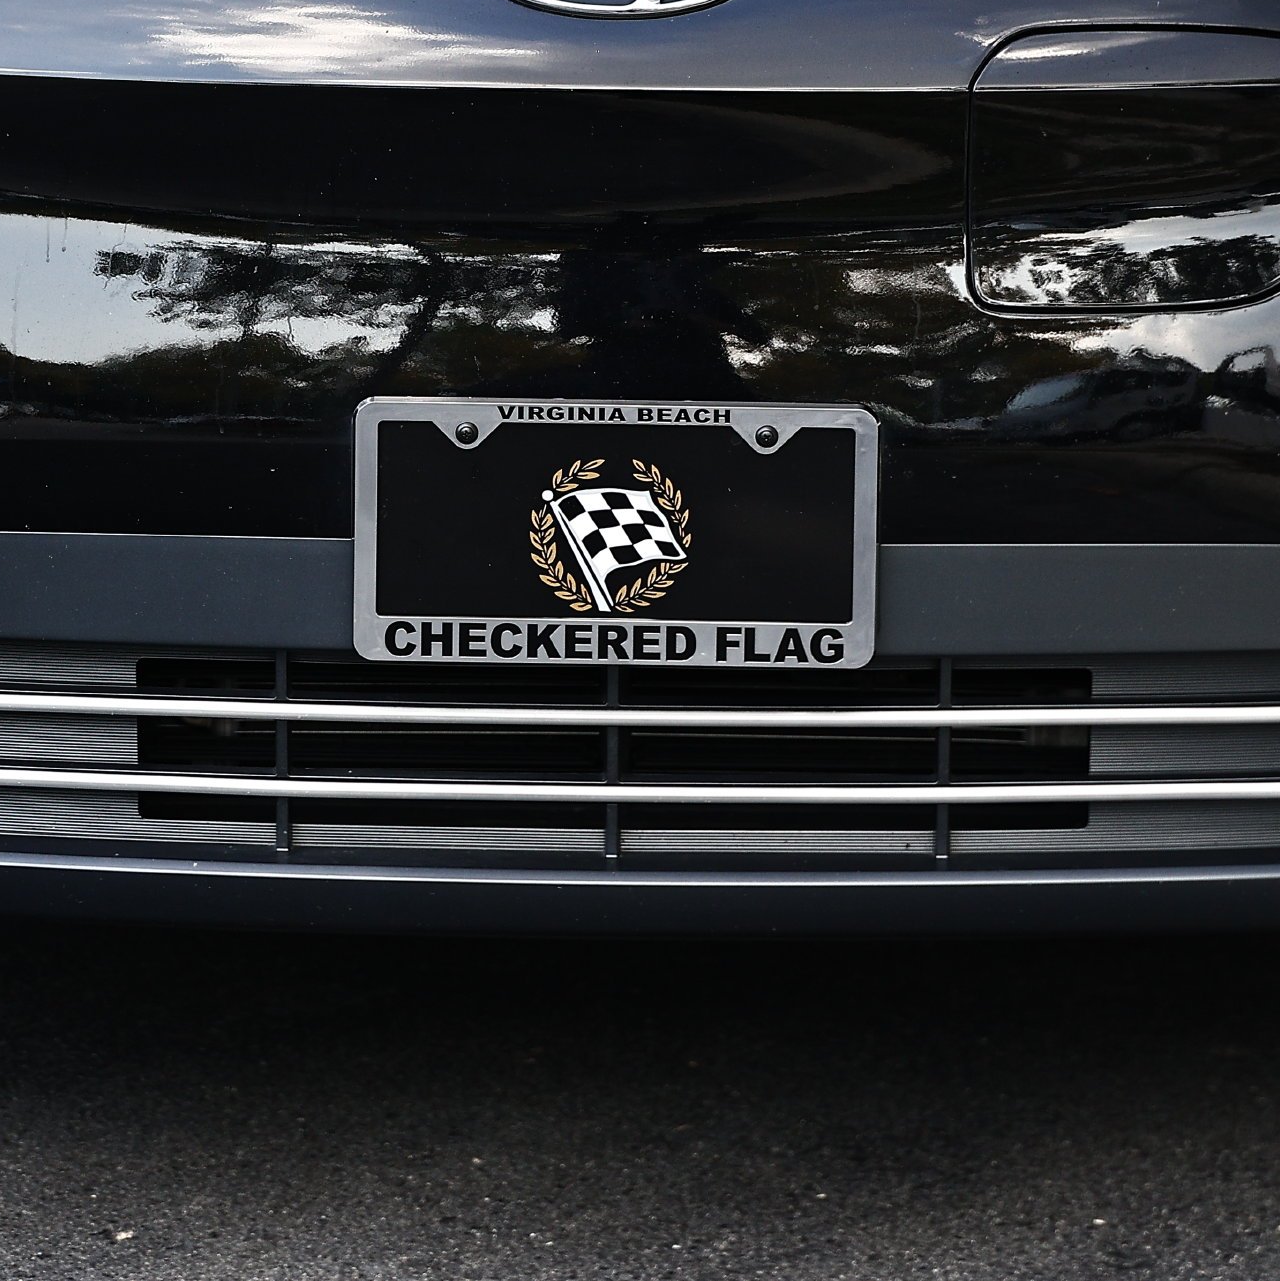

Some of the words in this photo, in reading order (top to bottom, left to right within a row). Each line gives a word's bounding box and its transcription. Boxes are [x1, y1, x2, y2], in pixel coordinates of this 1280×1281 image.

[497, 405, 626, 422] VIRGINIA
[637, 408, 731, 424] BEACH
[384, 620, 697, 662] CHECKERED
[715, 627, 845, 664] FLAG
